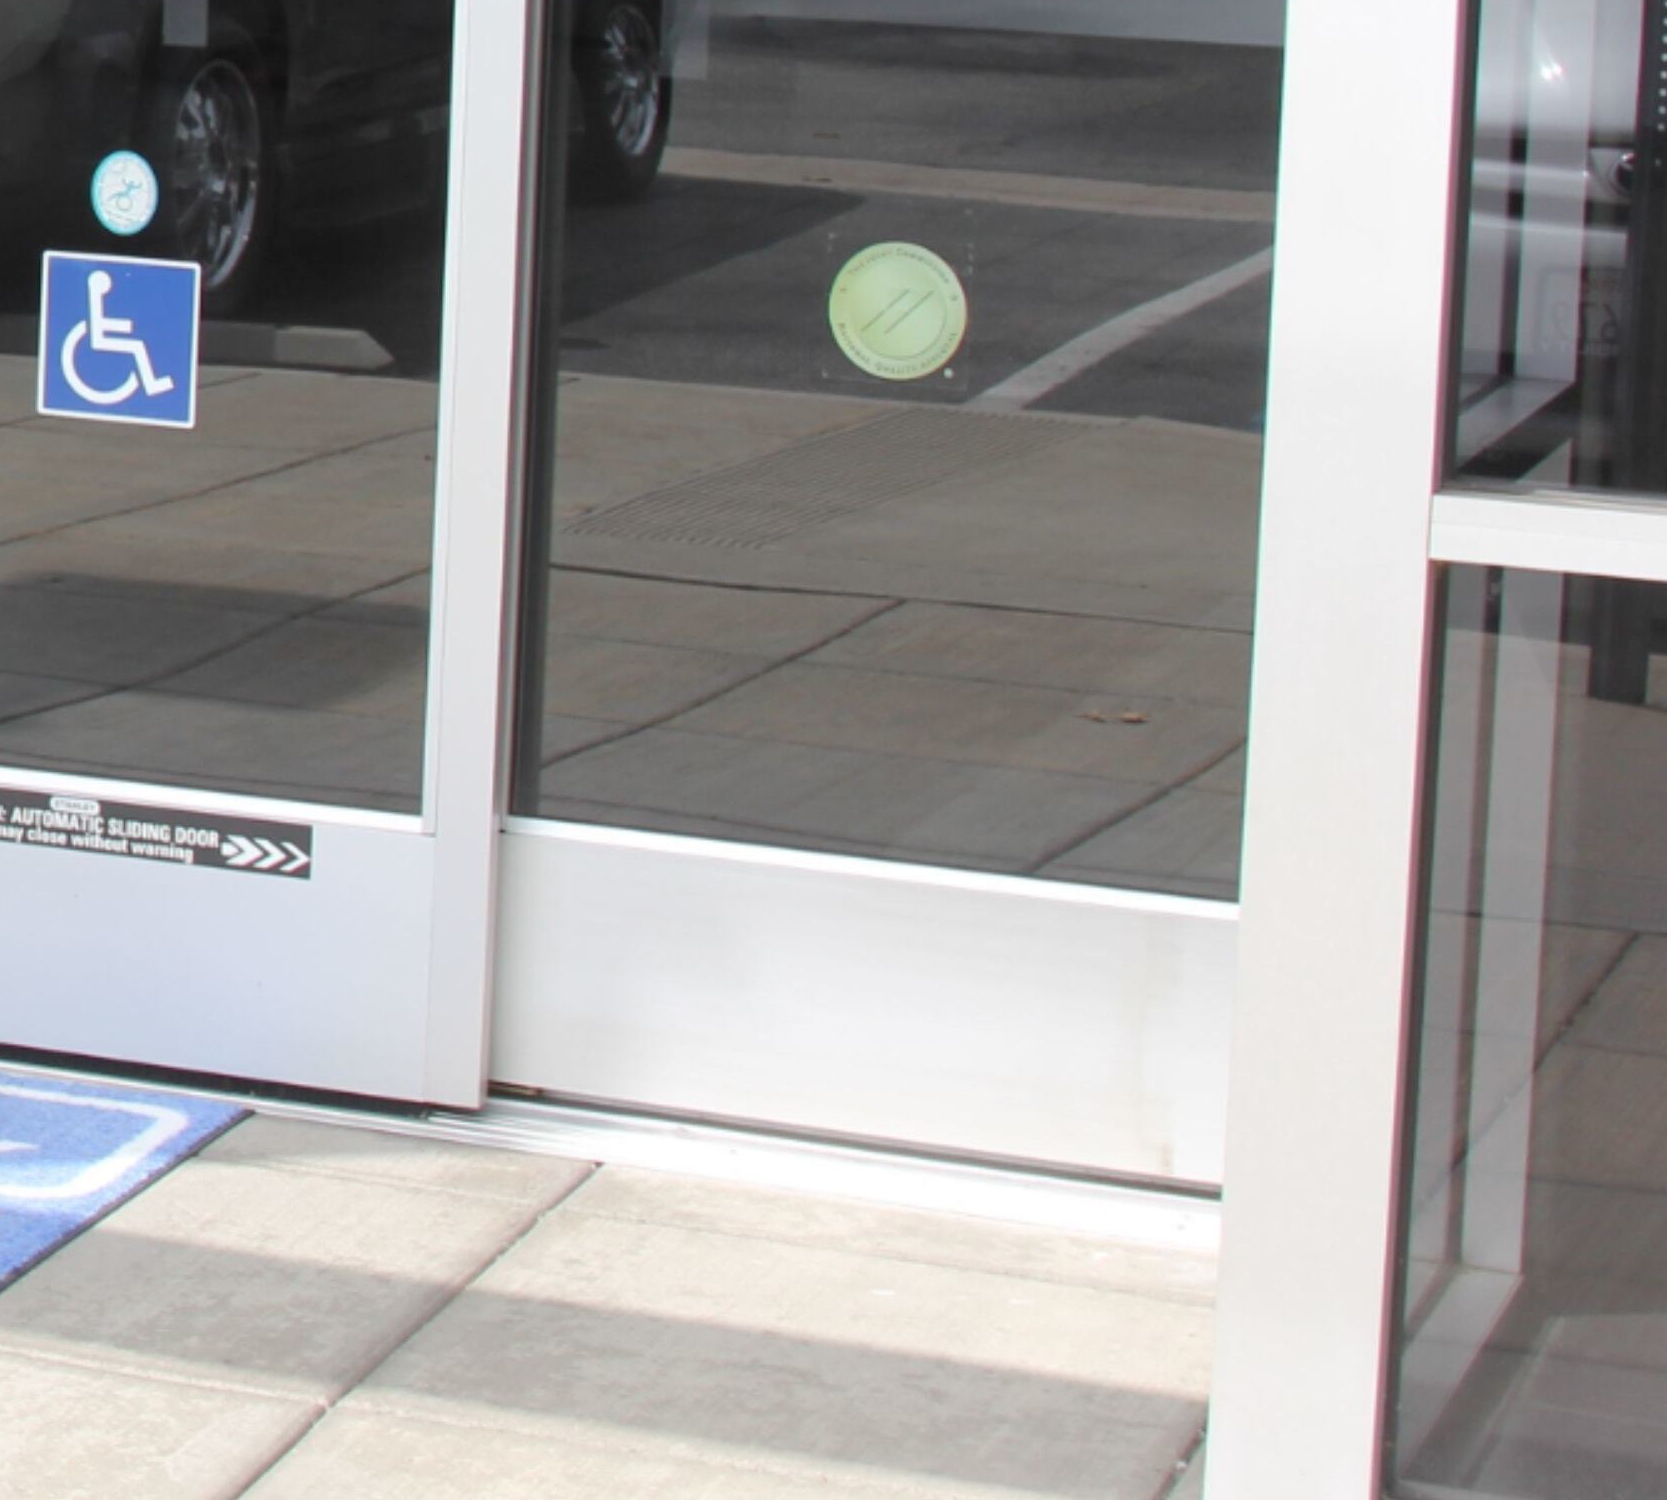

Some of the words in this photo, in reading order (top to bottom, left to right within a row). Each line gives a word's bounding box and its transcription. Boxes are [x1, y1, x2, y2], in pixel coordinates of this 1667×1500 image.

[10, 806, 105, 835] AUTOMATIC
[108, 818, 171, 843] SLIDING
[174, 827, 219, 848] DOOR
[27, 827, 68, 846] close
[71, 833, 129, 853] without
[132, 841, 194, 863] warning
